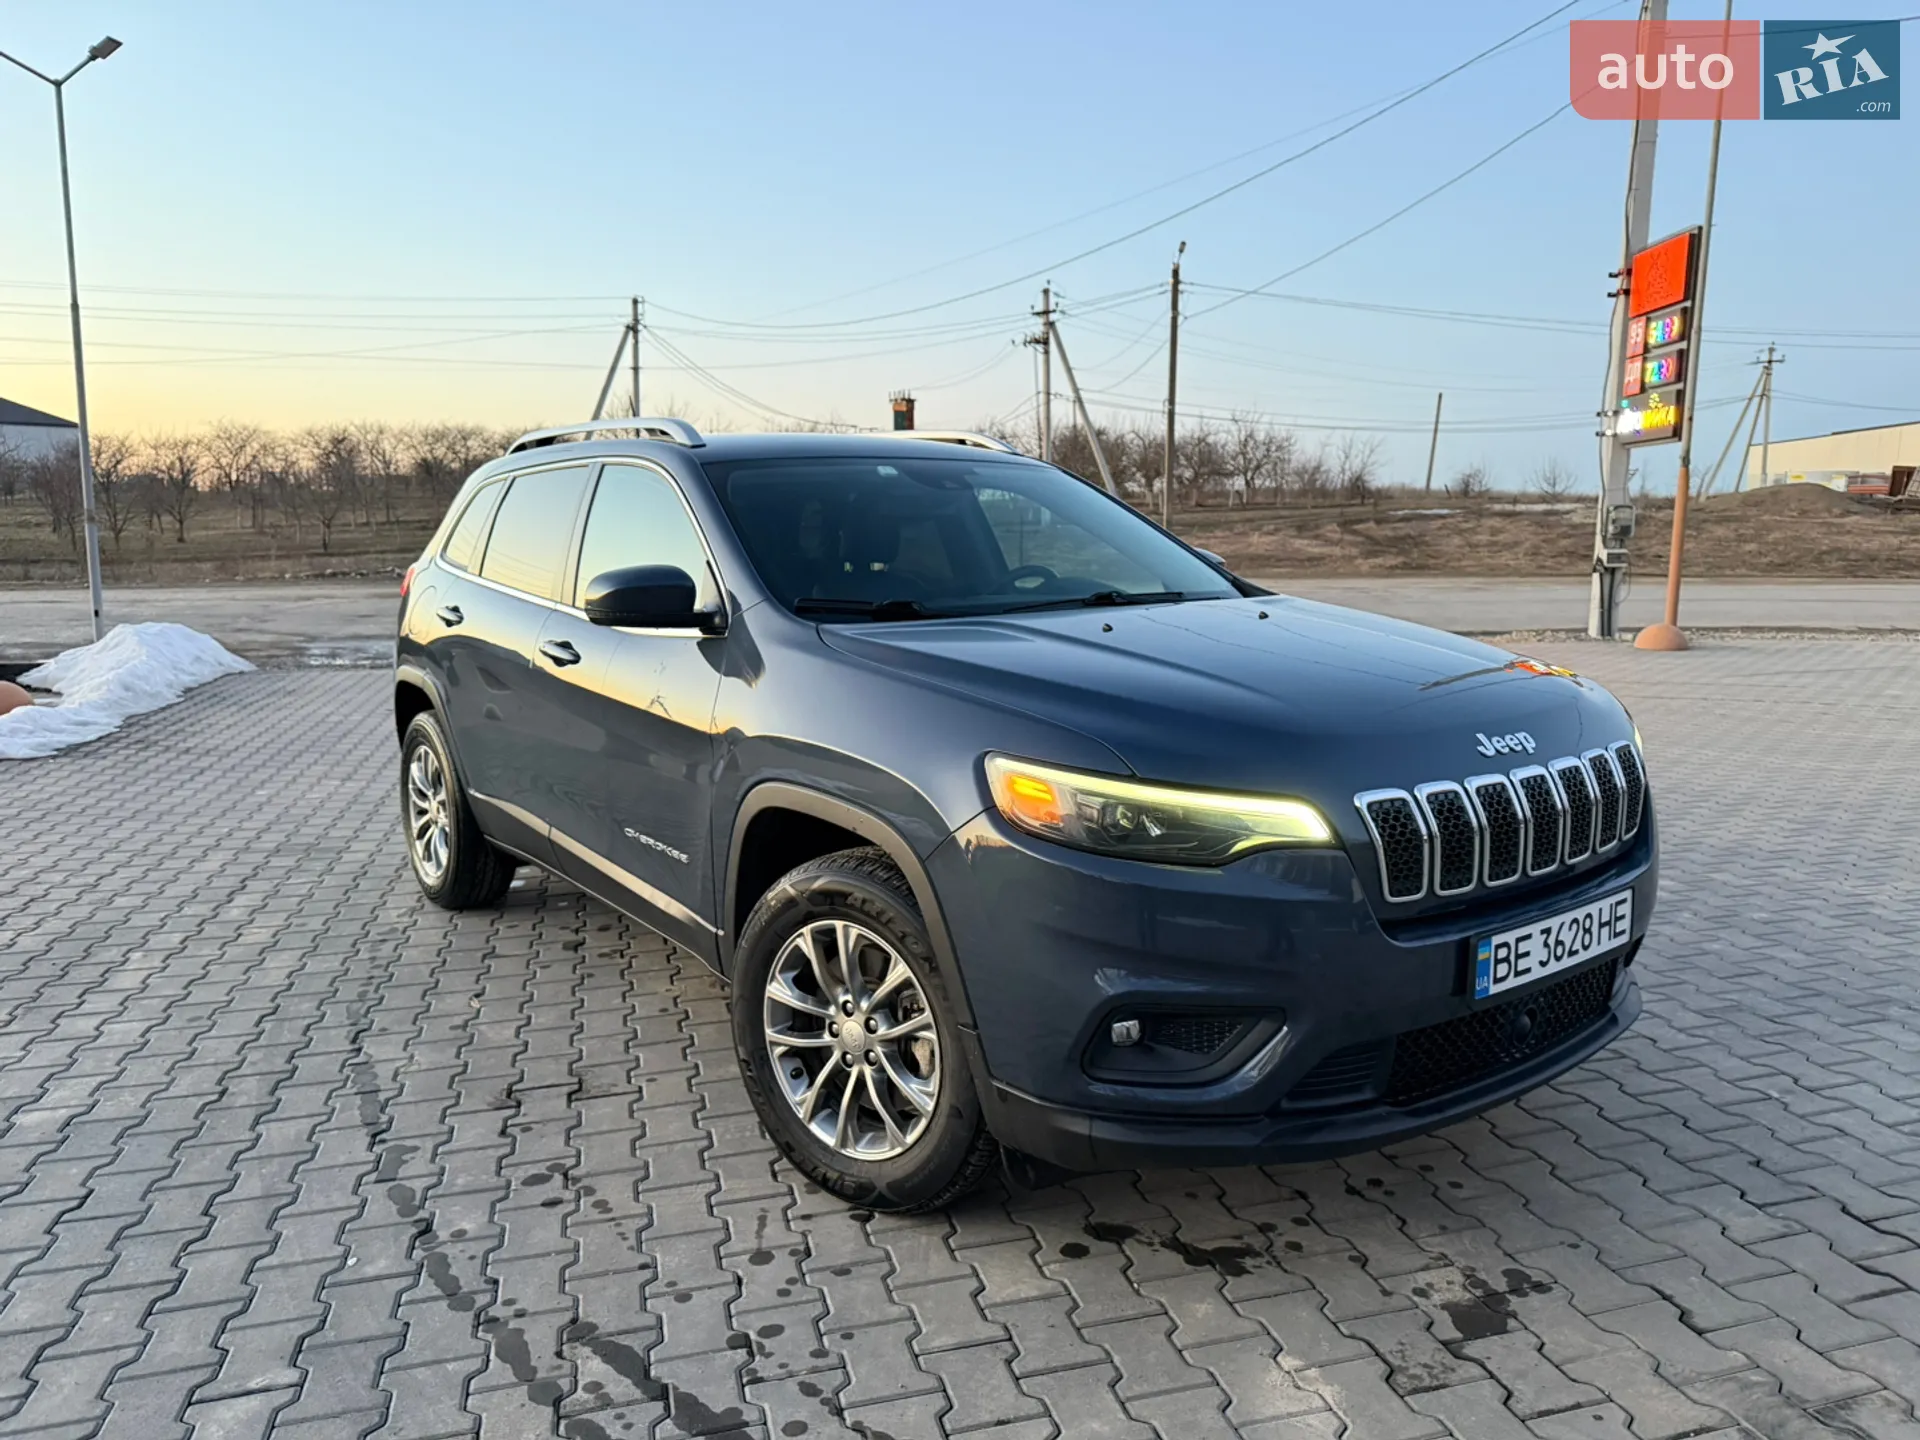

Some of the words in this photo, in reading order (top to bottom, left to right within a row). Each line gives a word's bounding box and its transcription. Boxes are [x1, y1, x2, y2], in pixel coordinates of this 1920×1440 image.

[1475, 731, 1536, 757] Jeep
[1493, 932, 1533, 985] BE
[1538, 912, 1594, 968] 3628
[1597, 897, 1628, 946] HE
[1476, 976, 1489, 991] UA
